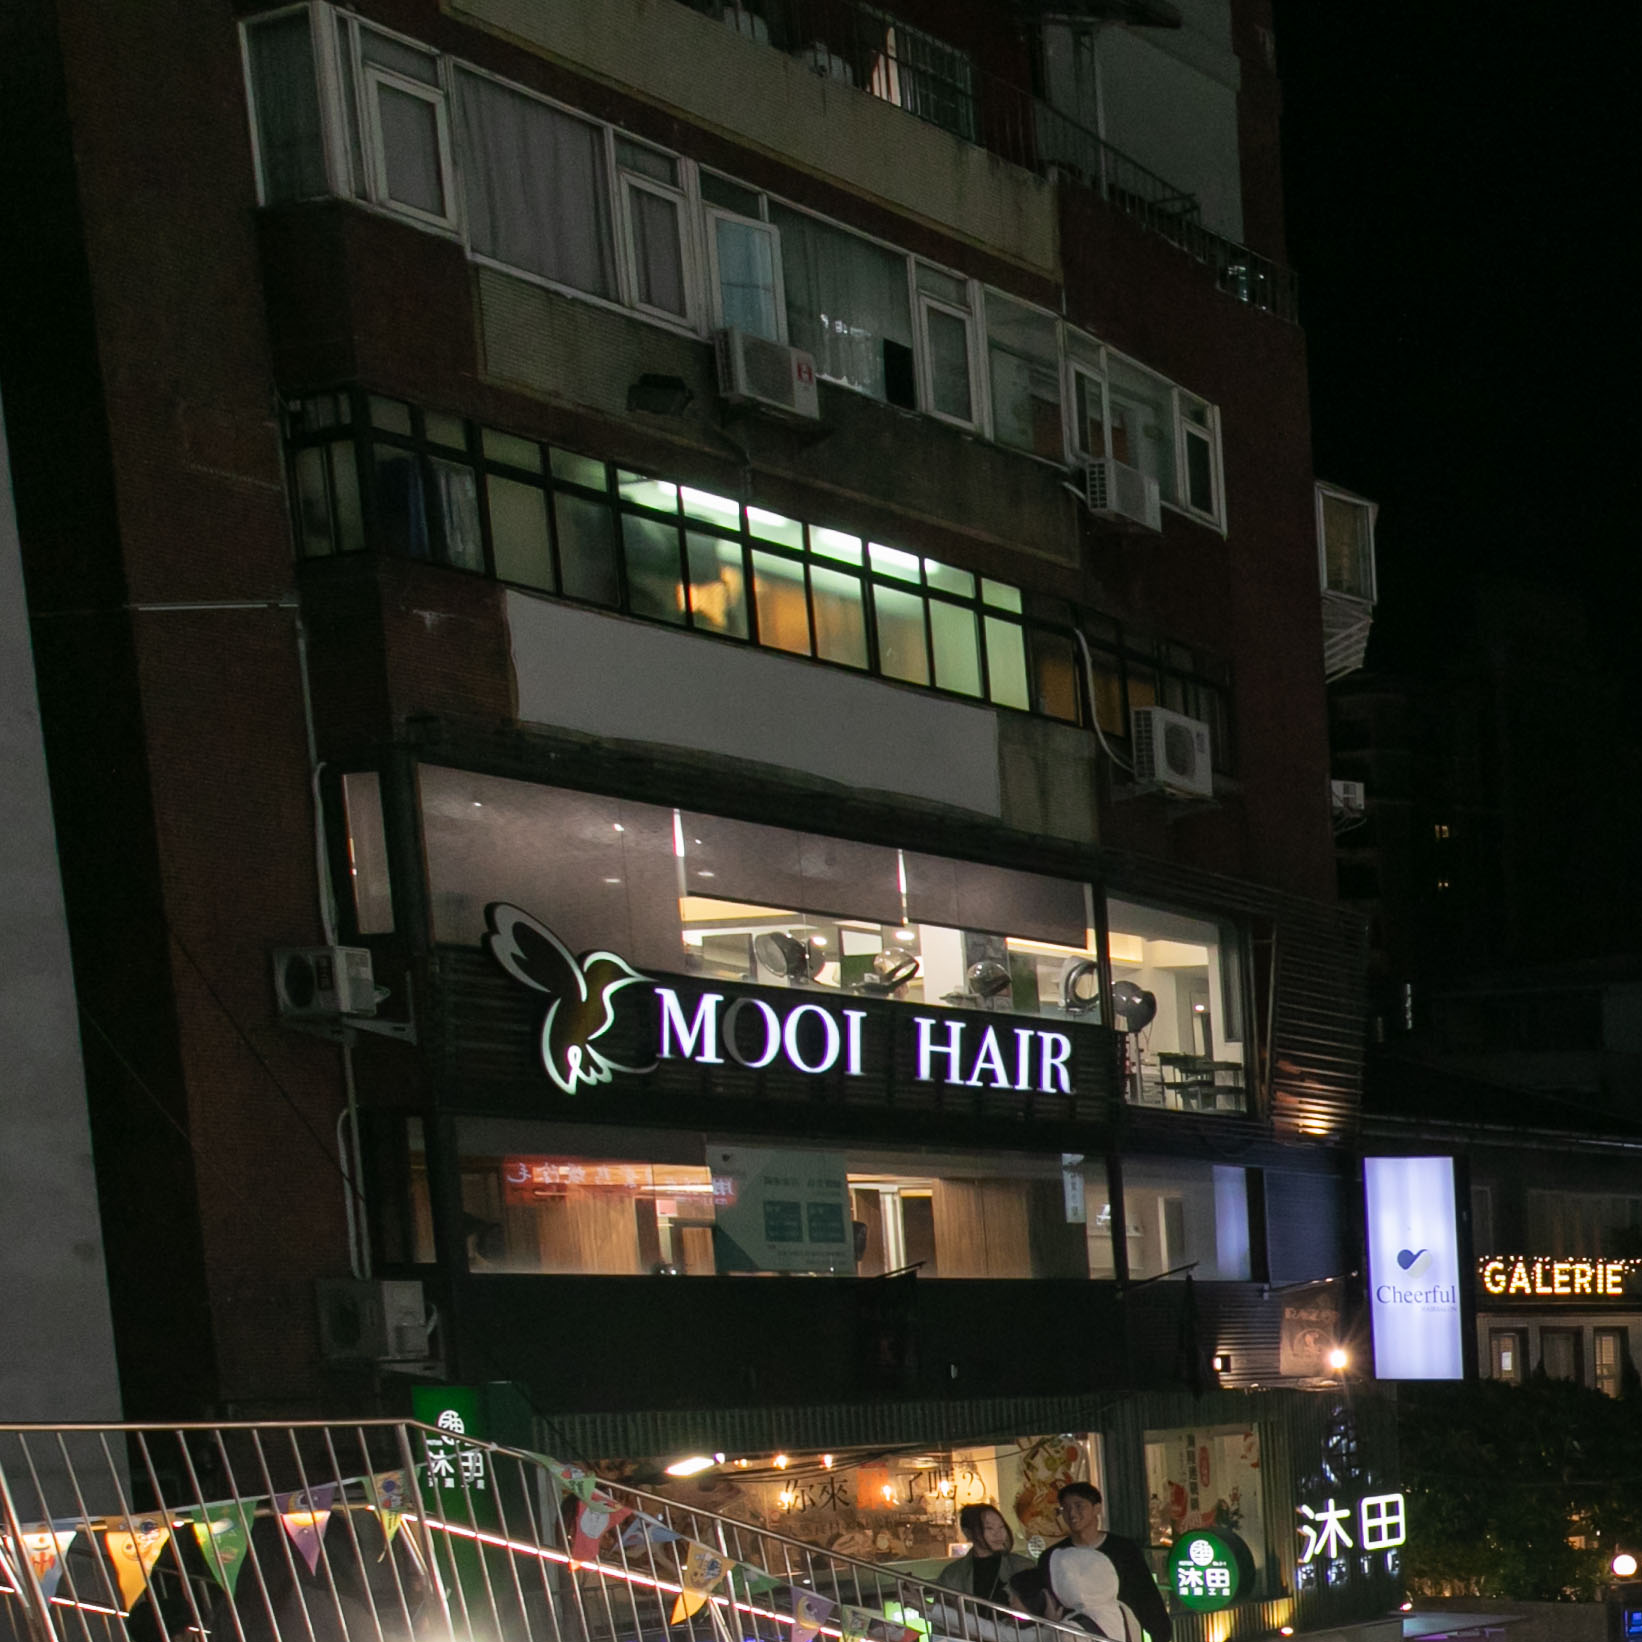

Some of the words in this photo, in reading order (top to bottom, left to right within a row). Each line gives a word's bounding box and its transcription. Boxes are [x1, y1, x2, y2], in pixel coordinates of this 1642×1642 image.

[655, 988, 867, 1077] MOOI
[912, 1014, 1075, 1095] HAIR
[1376, 1285, 1456, 1304] Cheerful
[1484, 1259, 1623, 1296] GALERIE
[1297, 1493, 1406, 1564] 沐田
[1177, 1567, 1231, 1588] 沐田
